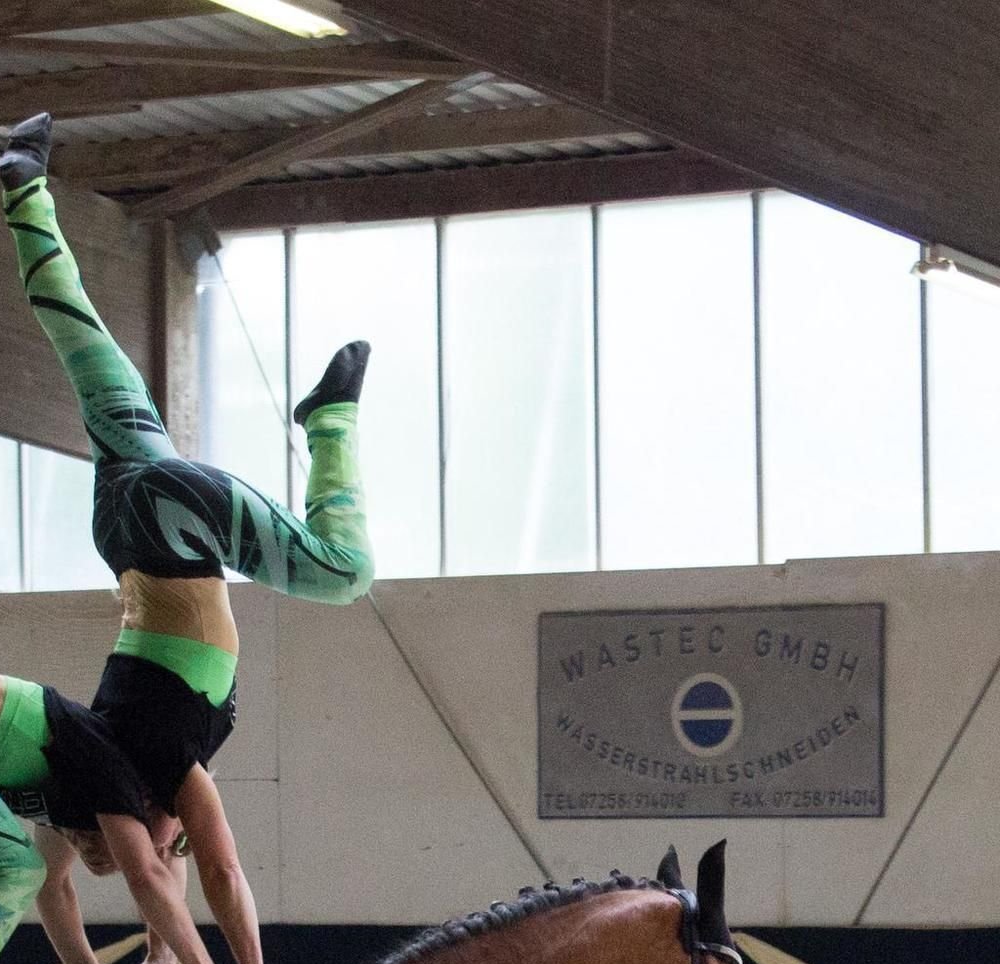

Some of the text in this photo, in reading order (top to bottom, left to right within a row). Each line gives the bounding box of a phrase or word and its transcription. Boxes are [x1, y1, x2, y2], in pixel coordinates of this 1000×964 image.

[560, 625, 859, 683] WASTEC GMBH
[556, 705, 862, 784] WASSERSTRAHLSCHNEIDEN
